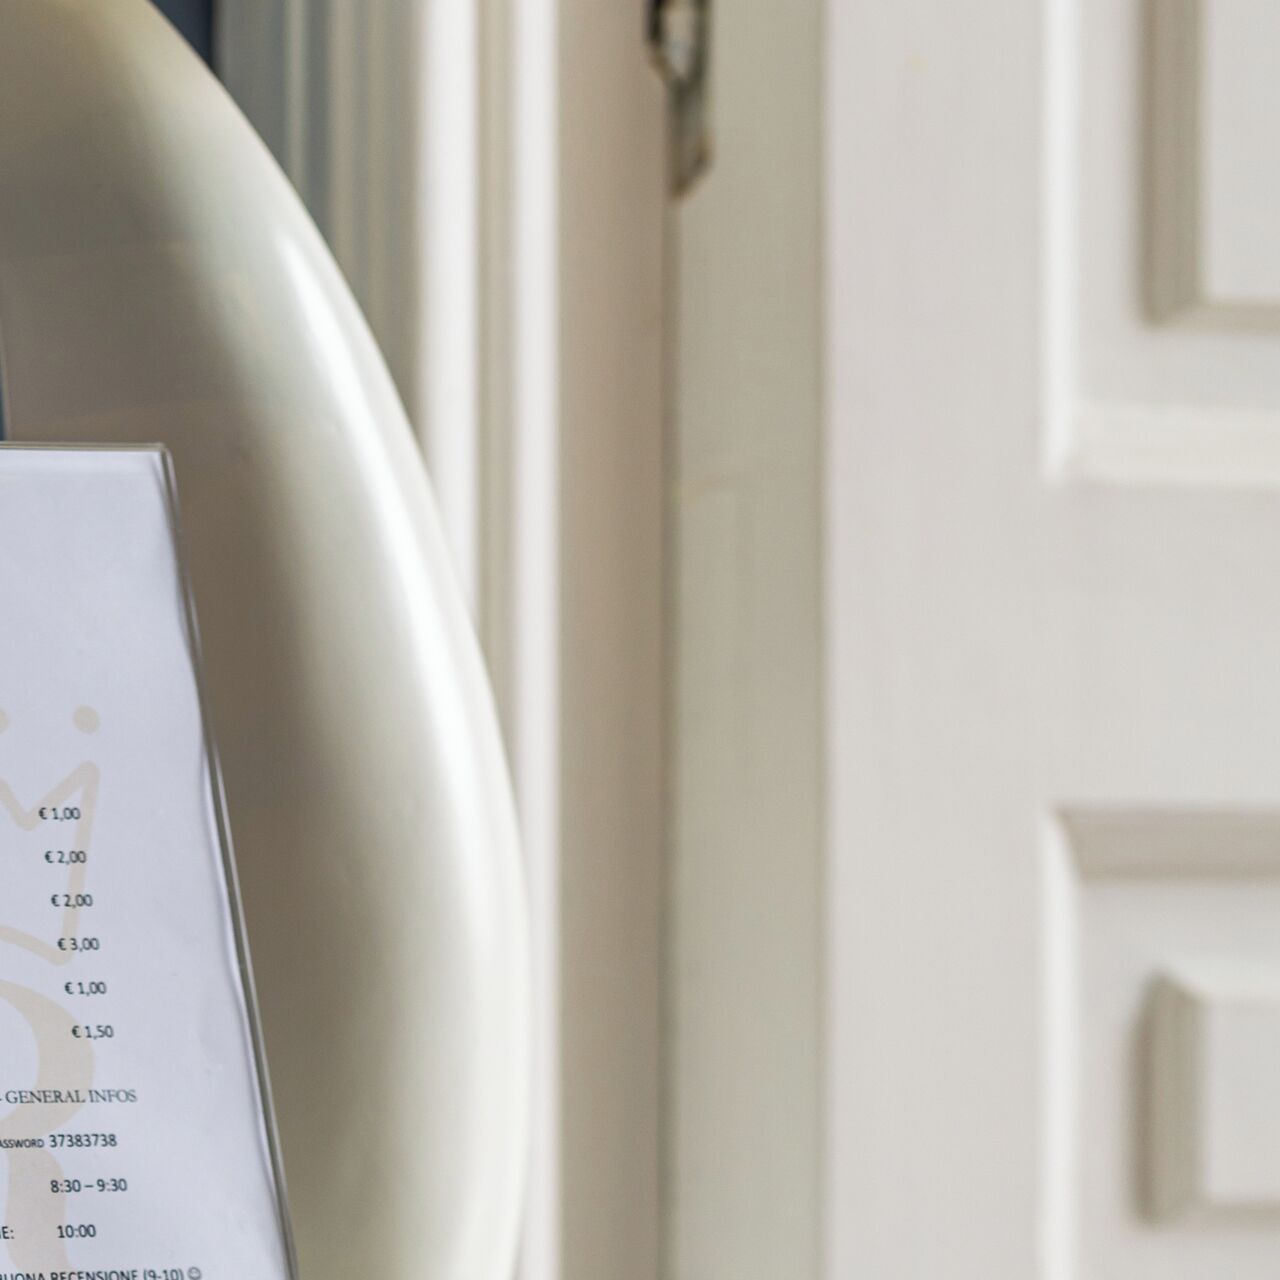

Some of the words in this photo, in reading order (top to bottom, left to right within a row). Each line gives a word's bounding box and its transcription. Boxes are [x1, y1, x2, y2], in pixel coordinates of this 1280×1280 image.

[52, 807, 81, 822] 1,00
[57, 850, 87, 865] 2,00
[63, 894, 93, 909] 2,00
[70, 938, 100, 952] 3,00
[78, 982, 107, 996] 1,00
[85, 1025, 114, 1040] 1,50
[5, 1090, 86, 1104] GENERAL
[88, 1089, 138, 1103] INFOS
[48, 1134, 118, 1148] 37383738
[50, 1180, 81, 1194] 8:30
[97, 1178, 128, 1192] 9:30
[57, 1224, 97, 1239] 10:00
